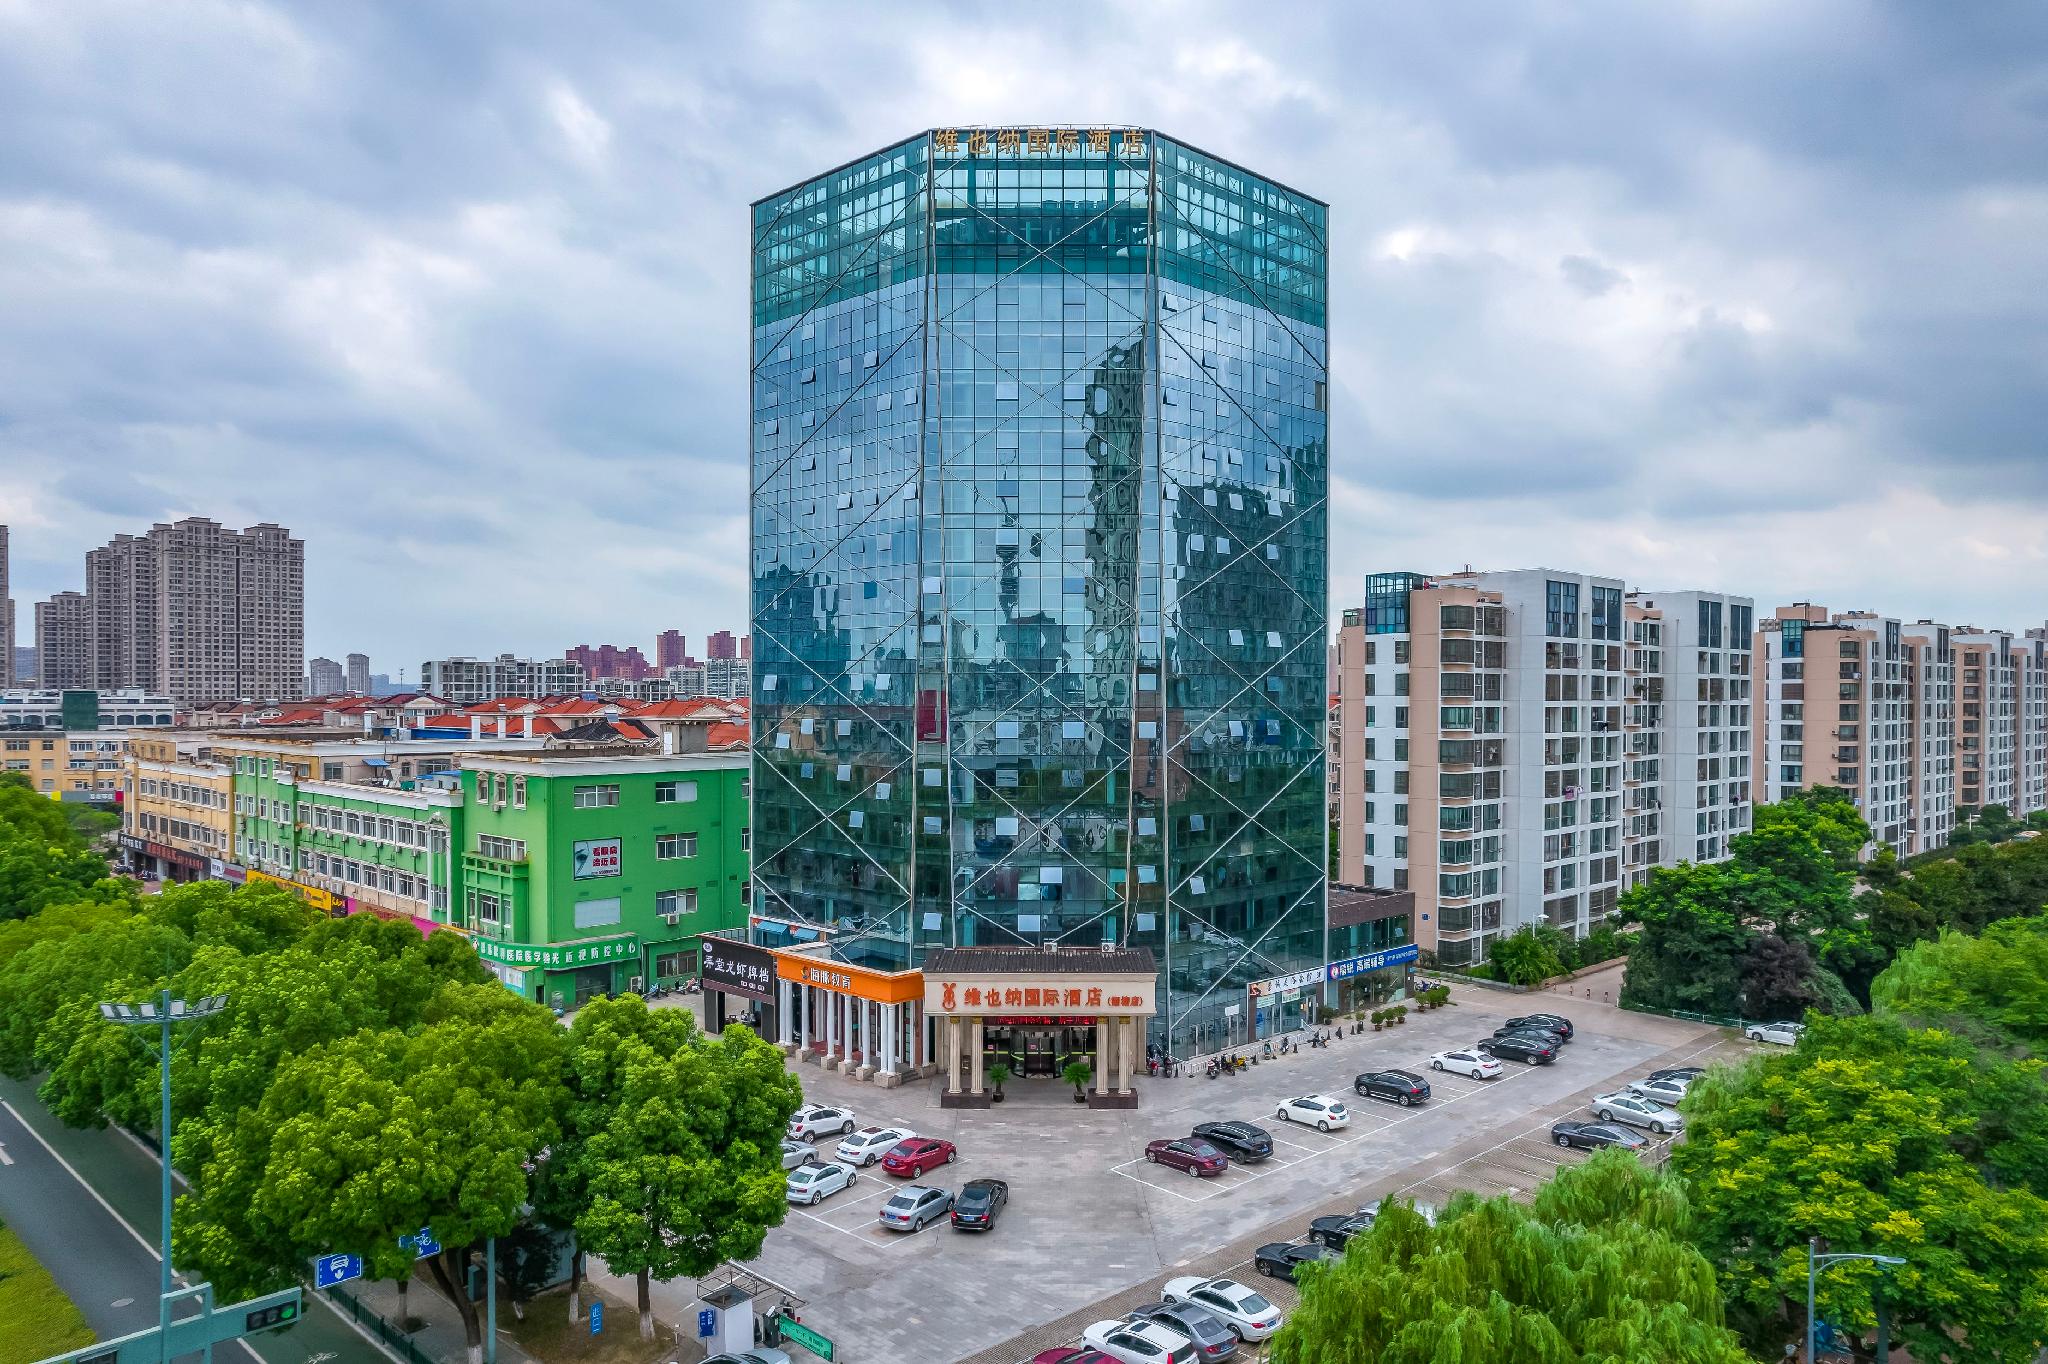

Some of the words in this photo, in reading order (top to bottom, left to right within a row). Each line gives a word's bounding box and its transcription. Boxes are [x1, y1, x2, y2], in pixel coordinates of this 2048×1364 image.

[935, 127, 1145, 155] 维也纳国际酒店
[565, 941, 636, 964] 近视防控中心
[810, 967, 851, 990] 海豚教育
[964, 987, 1103, 1007] 维也纳国际酒店
